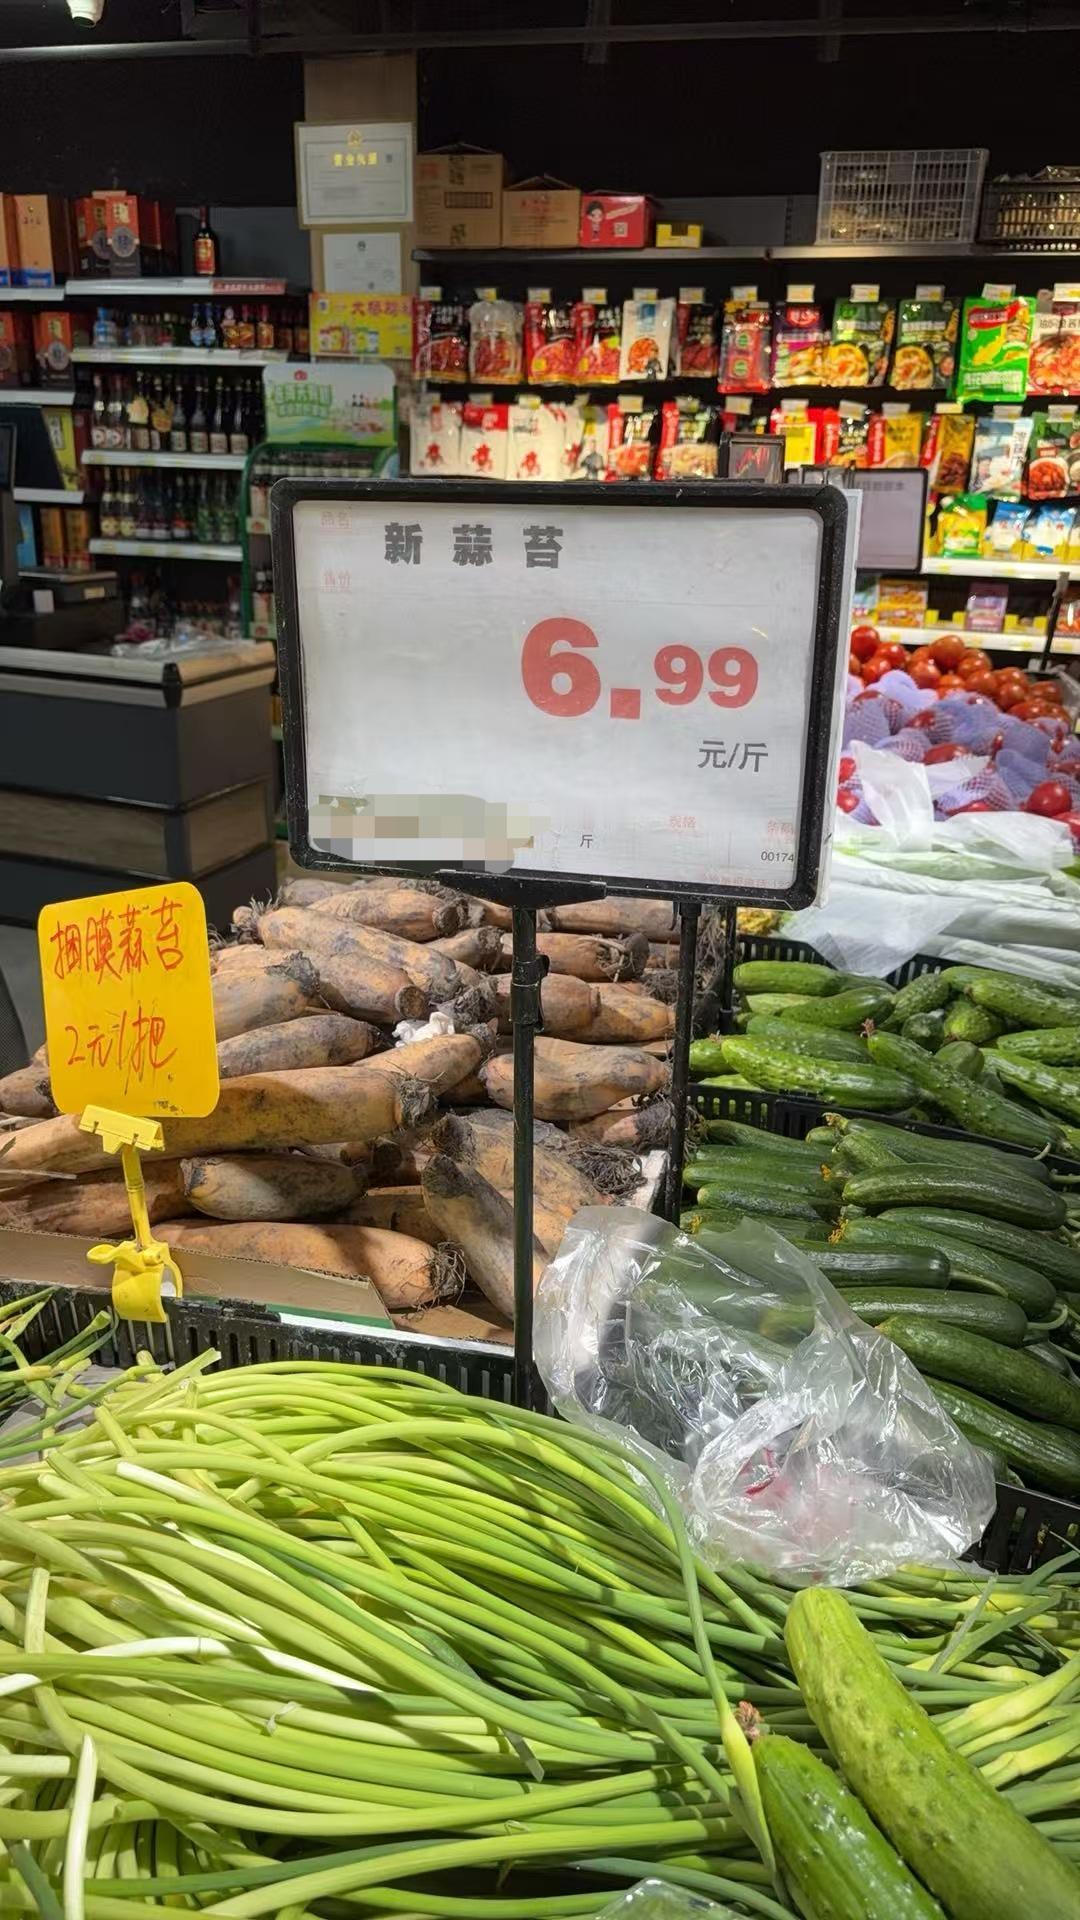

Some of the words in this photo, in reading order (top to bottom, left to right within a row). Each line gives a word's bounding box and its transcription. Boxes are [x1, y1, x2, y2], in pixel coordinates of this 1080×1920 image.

[384, 522, 563, 568] 新蒜苔
[521, 617, 758, 719] 6.99
[698, 740, 768, 773] 元/斤
[580, 834, 593, 848] 斤
[760, 851, 794, 863] 00174
